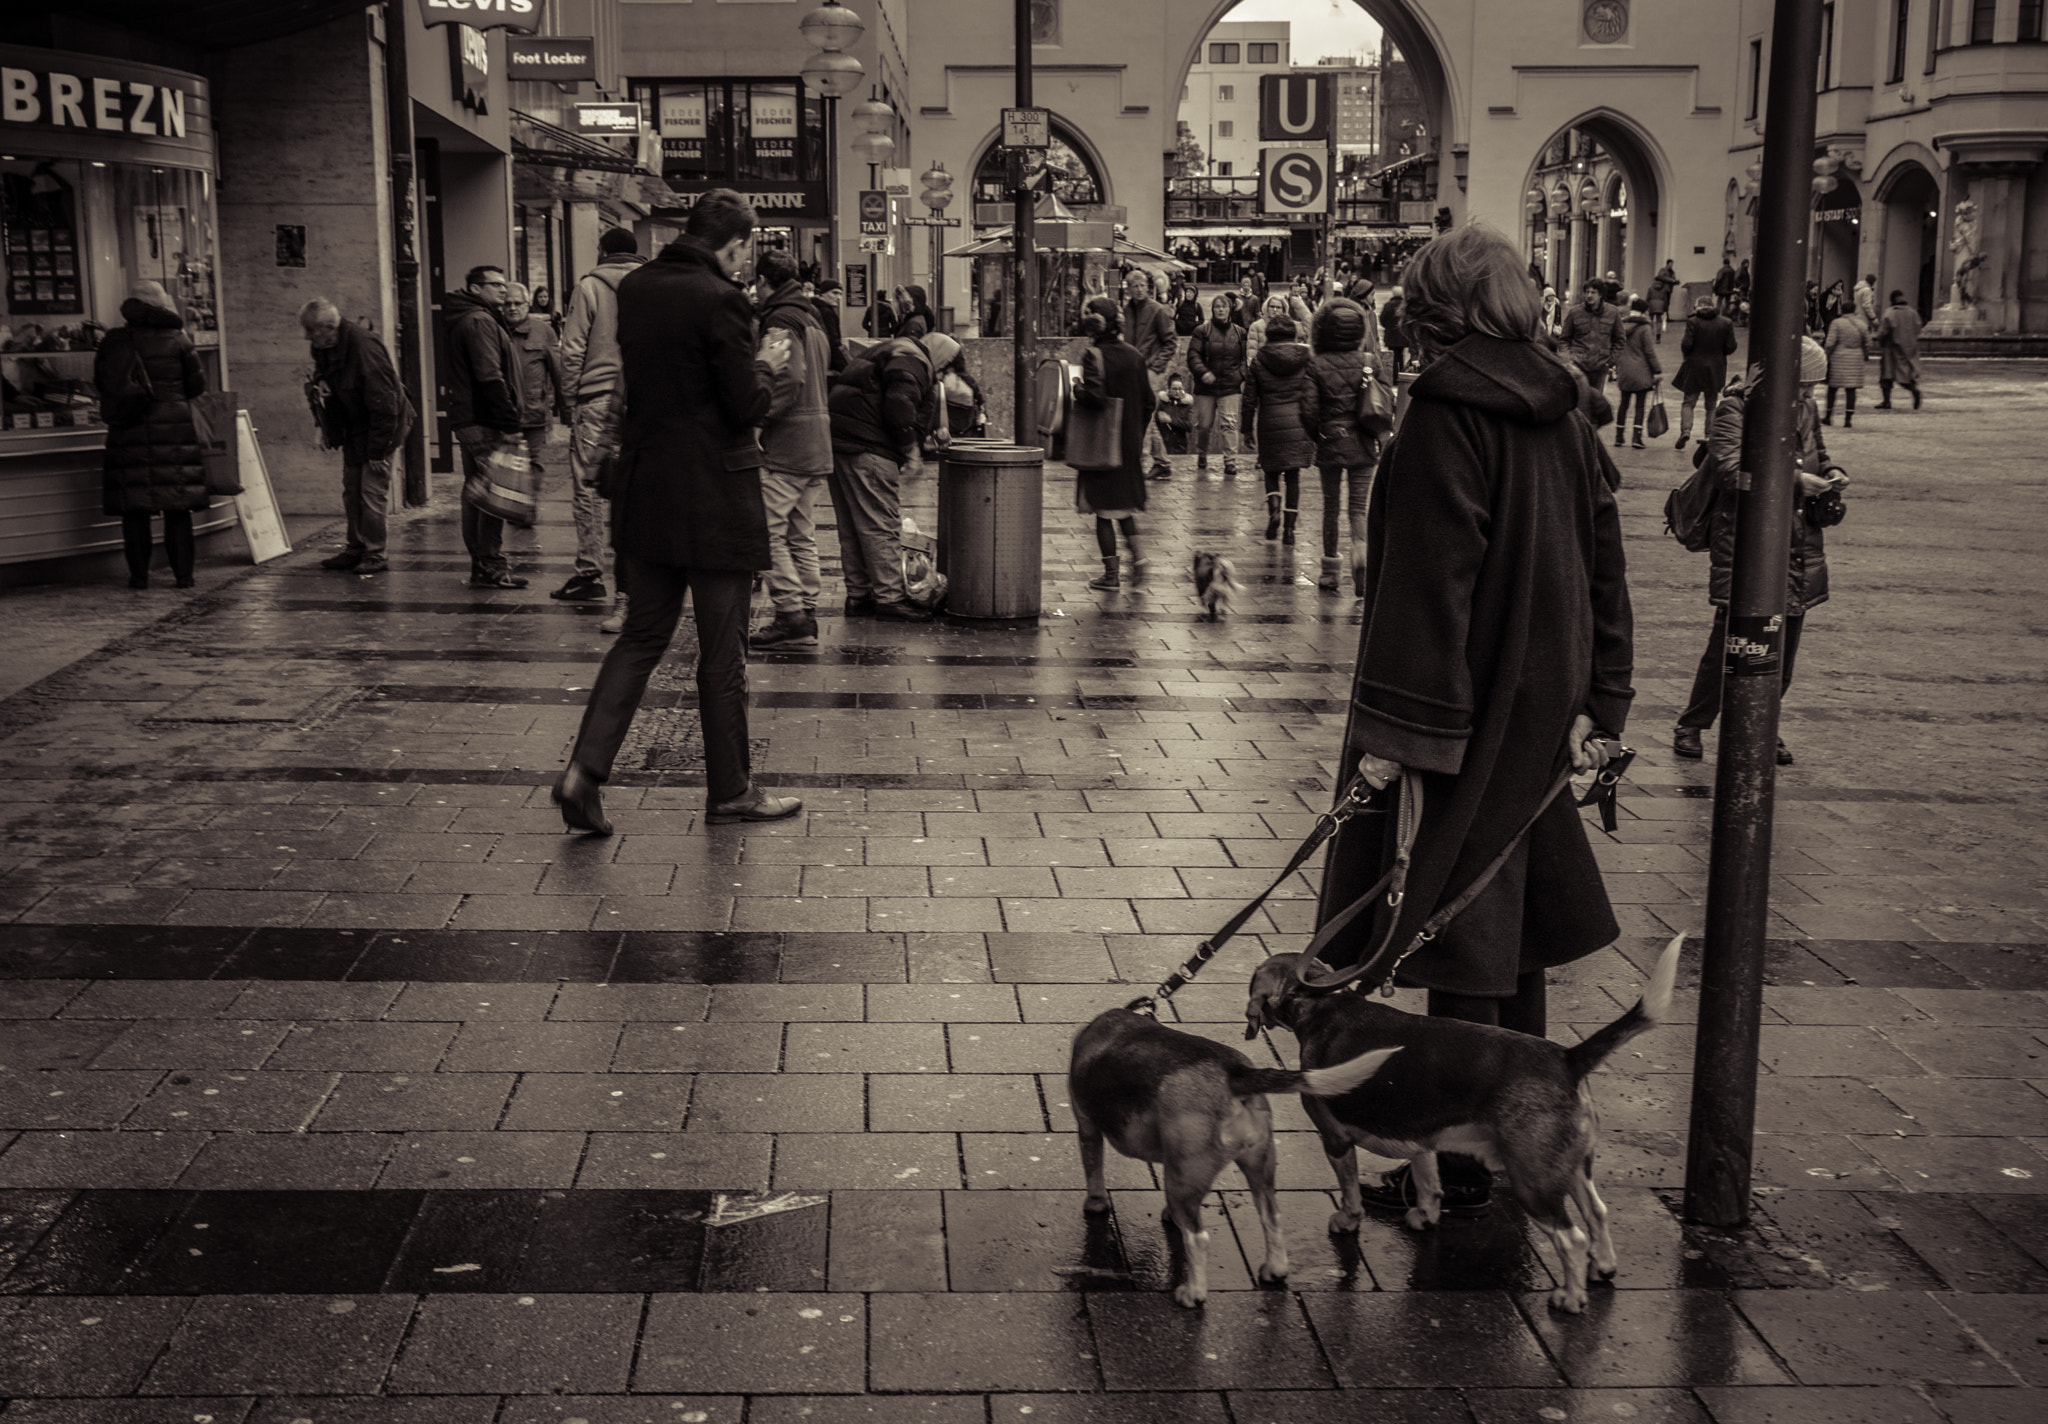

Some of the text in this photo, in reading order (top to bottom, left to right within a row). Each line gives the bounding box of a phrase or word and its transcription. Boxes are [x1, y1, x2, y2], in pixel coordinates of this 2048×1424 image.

[513, 52, 587, 65] Foot Locker
[1, 67, 186, 138] BREZN
[1280, 79, 1316, 134] U
[663, 108, 700, 117] LEDER
[754, 108, 792, 116] LEDER
[664, 118, 701, 126] FISCHER
[755, 118, 793, 126] FISCHER
[1008, 113, 1039, 122] H 300
[663, 140, 701, 149] LEDER
[755, 140, 793, 149] LEDER
[664, 150, 701, 158] FISCHER
[755, 150, 793, 158] FISCHER
[1280, 159, 1313, 202] S
[862, 222, 887, 232] TAXI
